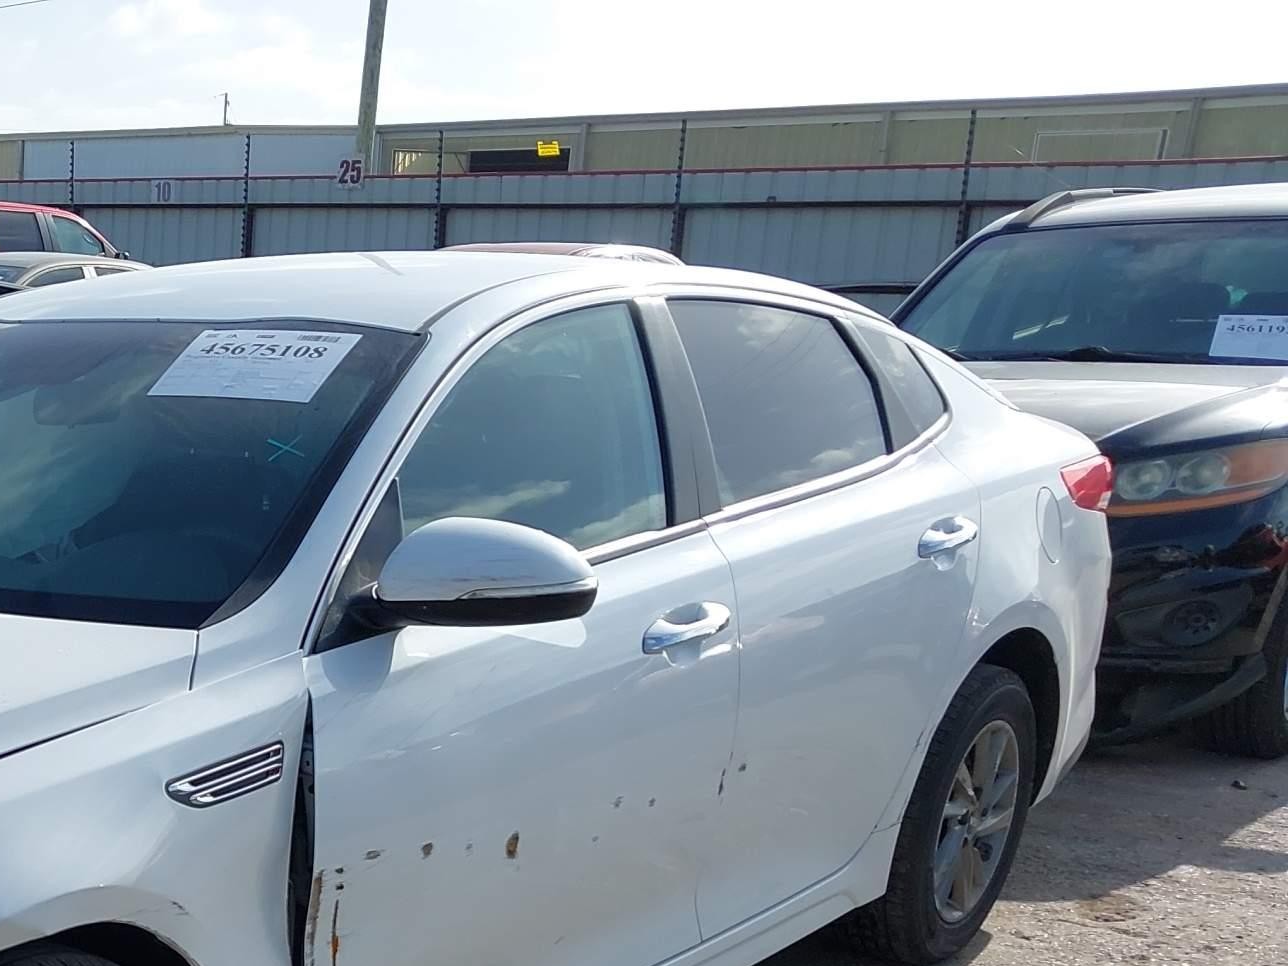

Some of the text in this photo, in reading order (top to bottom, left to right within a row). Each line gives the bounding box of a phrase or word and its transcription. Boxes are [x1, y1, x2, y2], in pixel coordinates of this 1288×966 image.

[338, 159, 362, 184] 25
[154, 181, 172, 202] 10
[1226, 324, 1288, 334] 456119
[200, 342, 328, 359] 45675108
